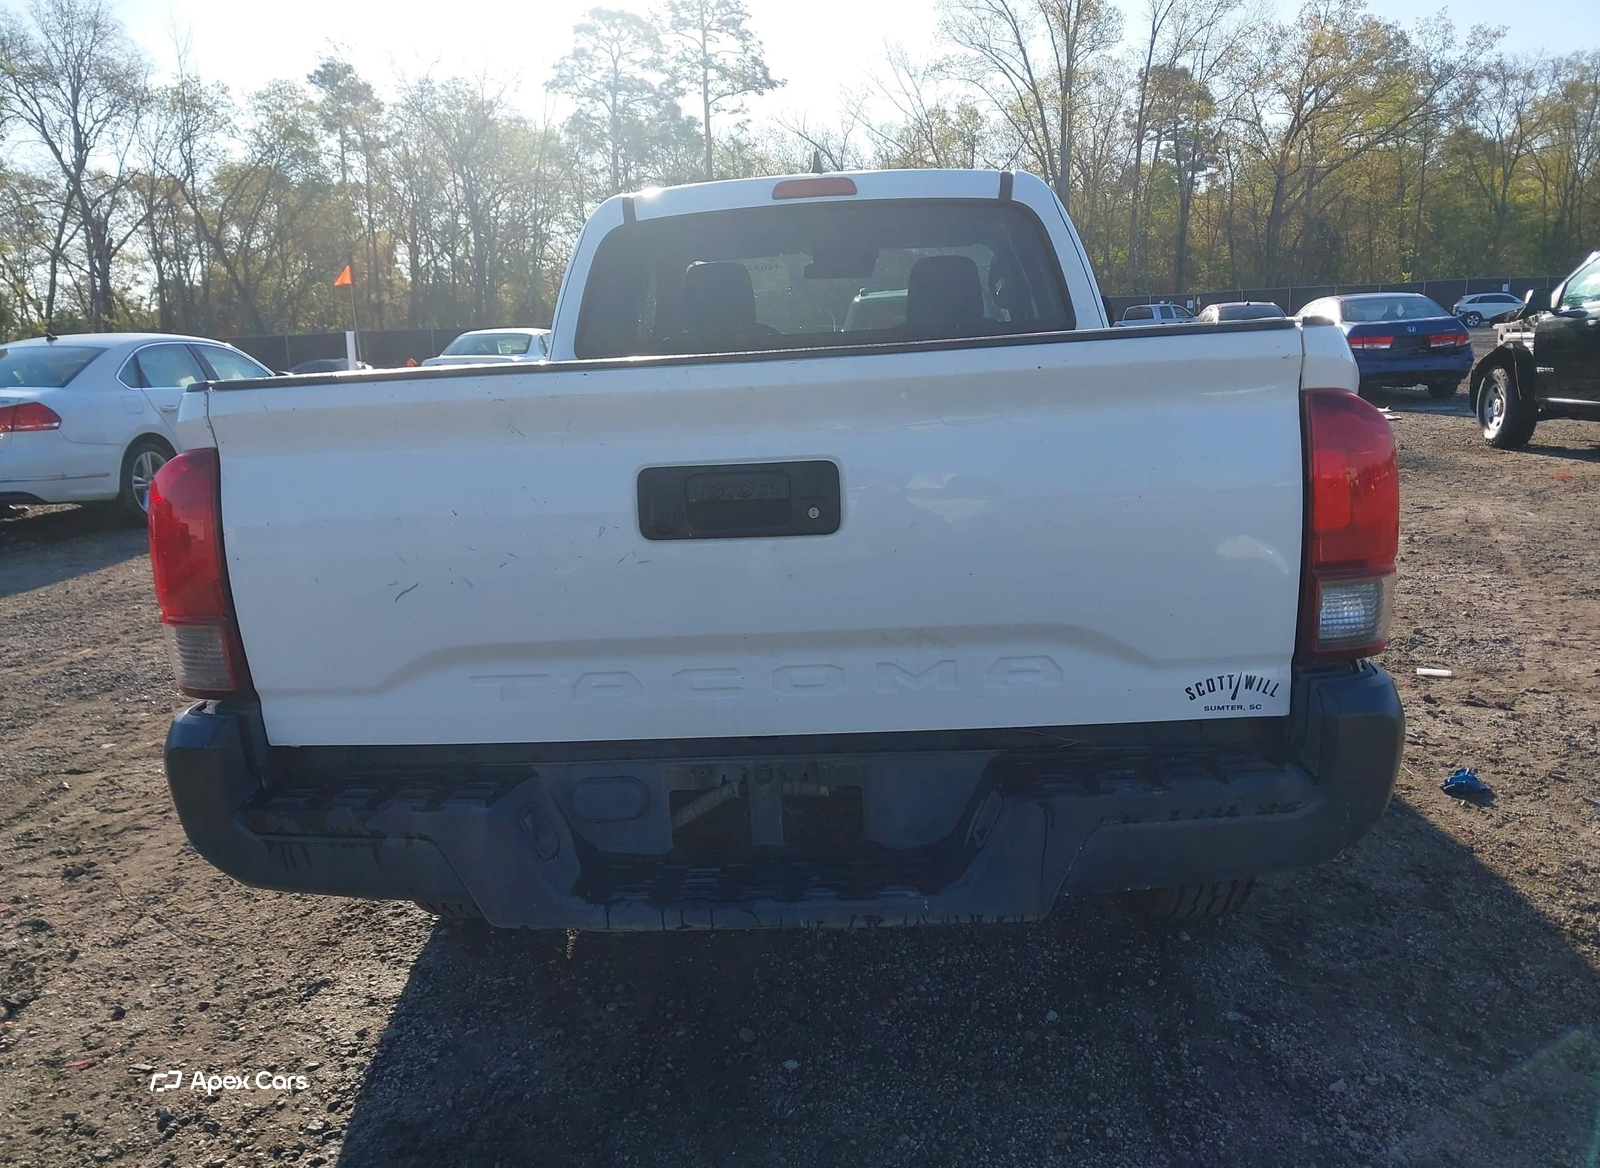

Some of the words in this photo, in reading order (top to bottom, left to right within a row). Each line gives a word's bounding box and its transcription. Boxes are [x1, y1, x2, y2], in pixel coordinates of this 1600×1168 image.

[699, 480, 781, 499] TOYOTA
[470, 655, 1064, 701] TACOMA
[1203, 704, 1246, 712] SUMTER,
